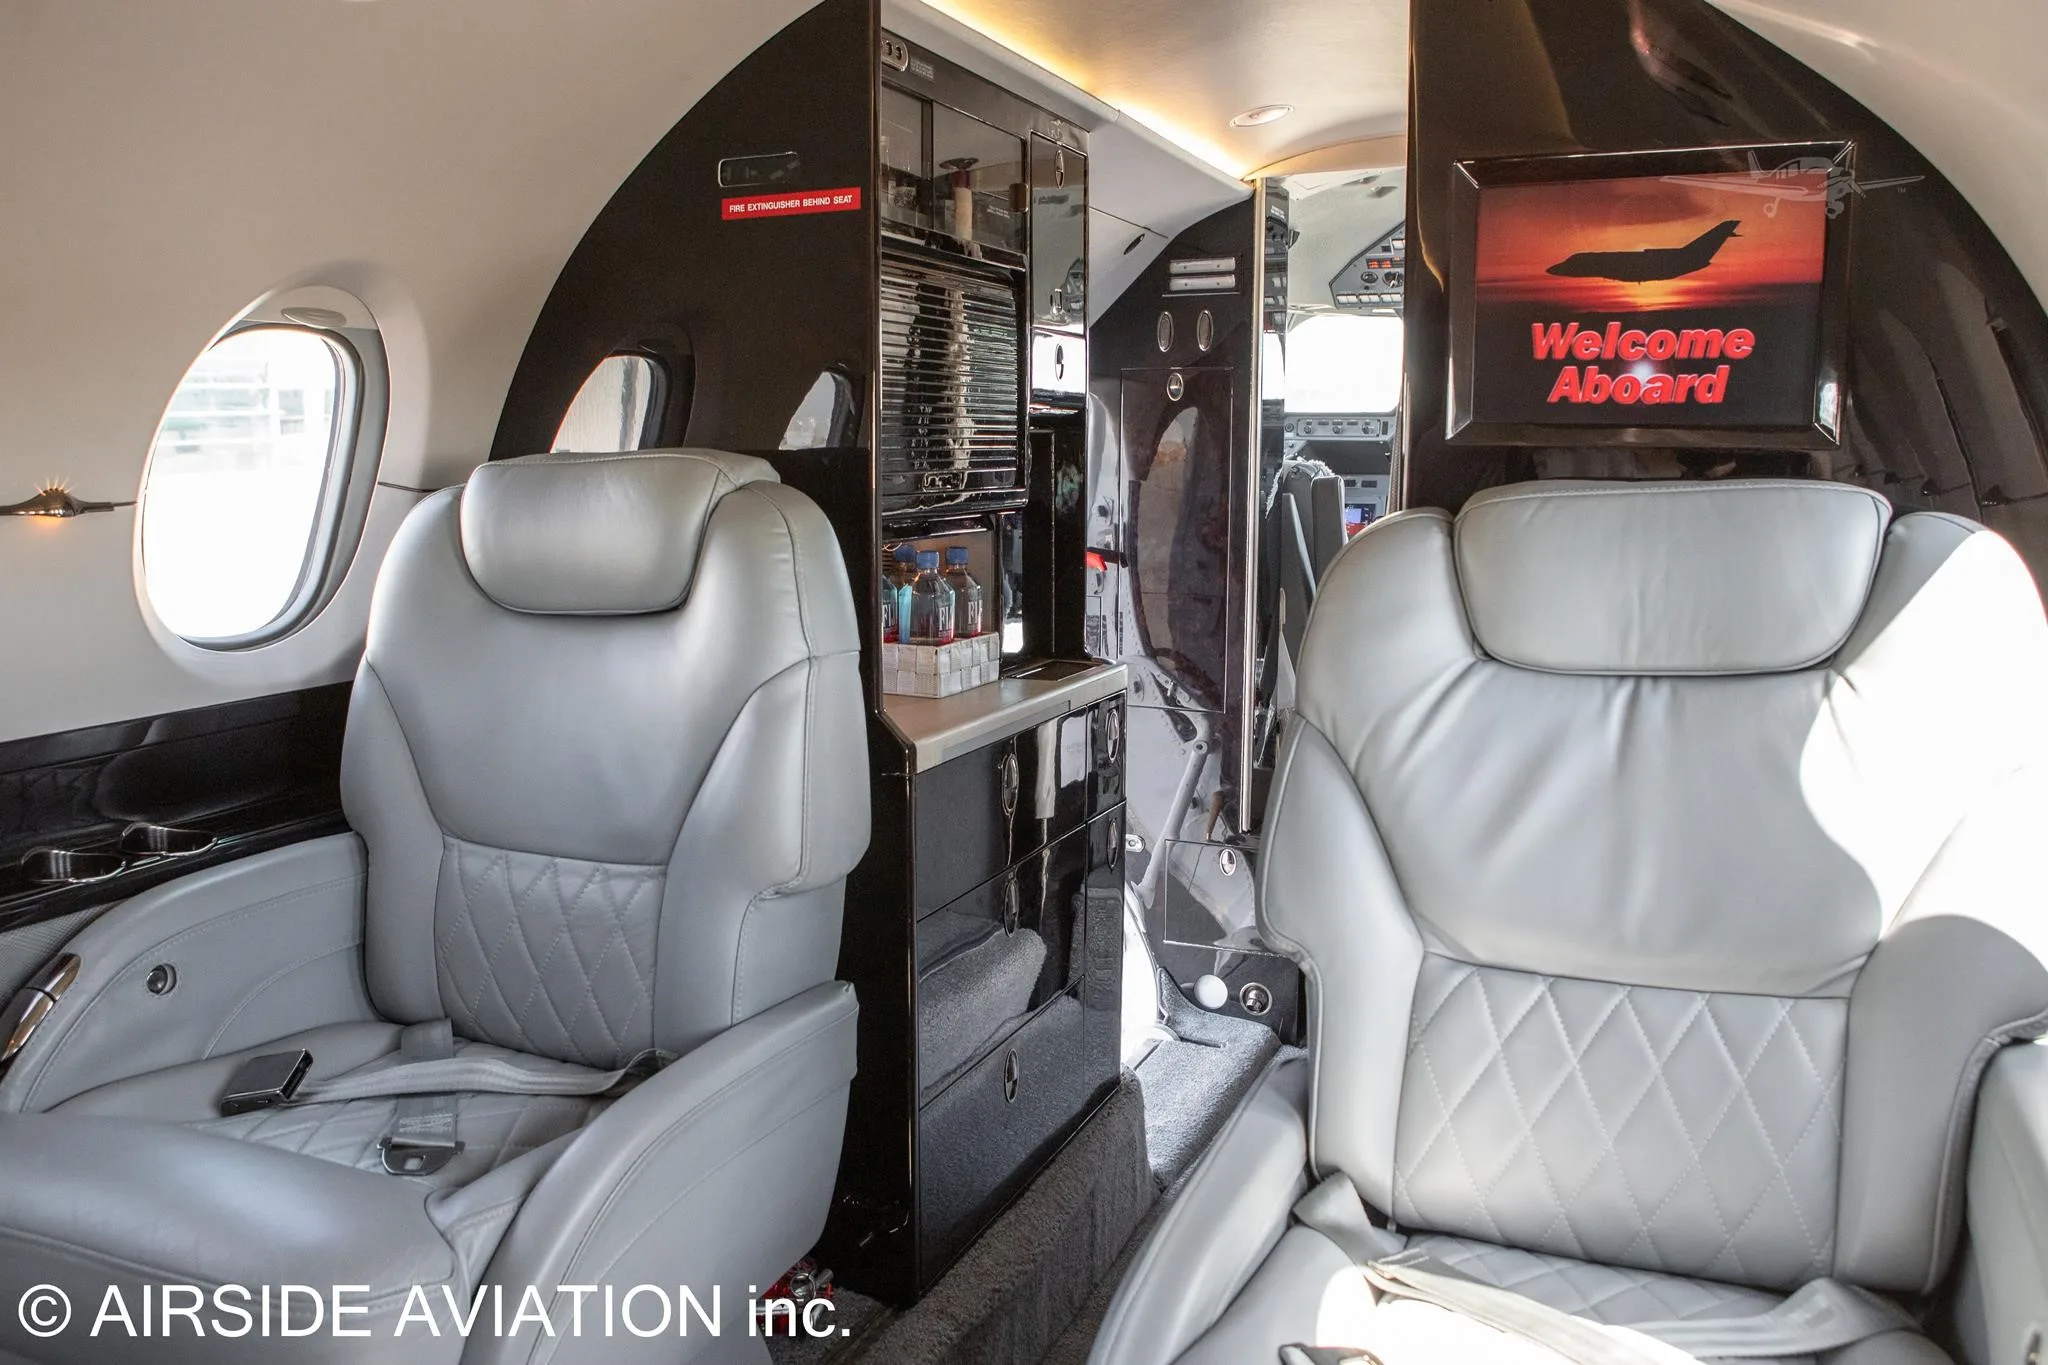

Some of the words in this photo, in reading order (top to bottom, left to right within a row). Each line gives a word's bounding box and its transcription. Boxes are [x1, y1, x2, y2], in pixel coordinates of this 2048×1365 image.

[729, 204, 745, 213] FIRE
[747, 199, 801, 212] EXTINGUISHER
[802, 197, 831, 207] BEHIND
[833, 194, 853, 205] SEAT
[1531, 321, 1756, 361] Welcome
[1547, 365, 1731, 405] Aboard
